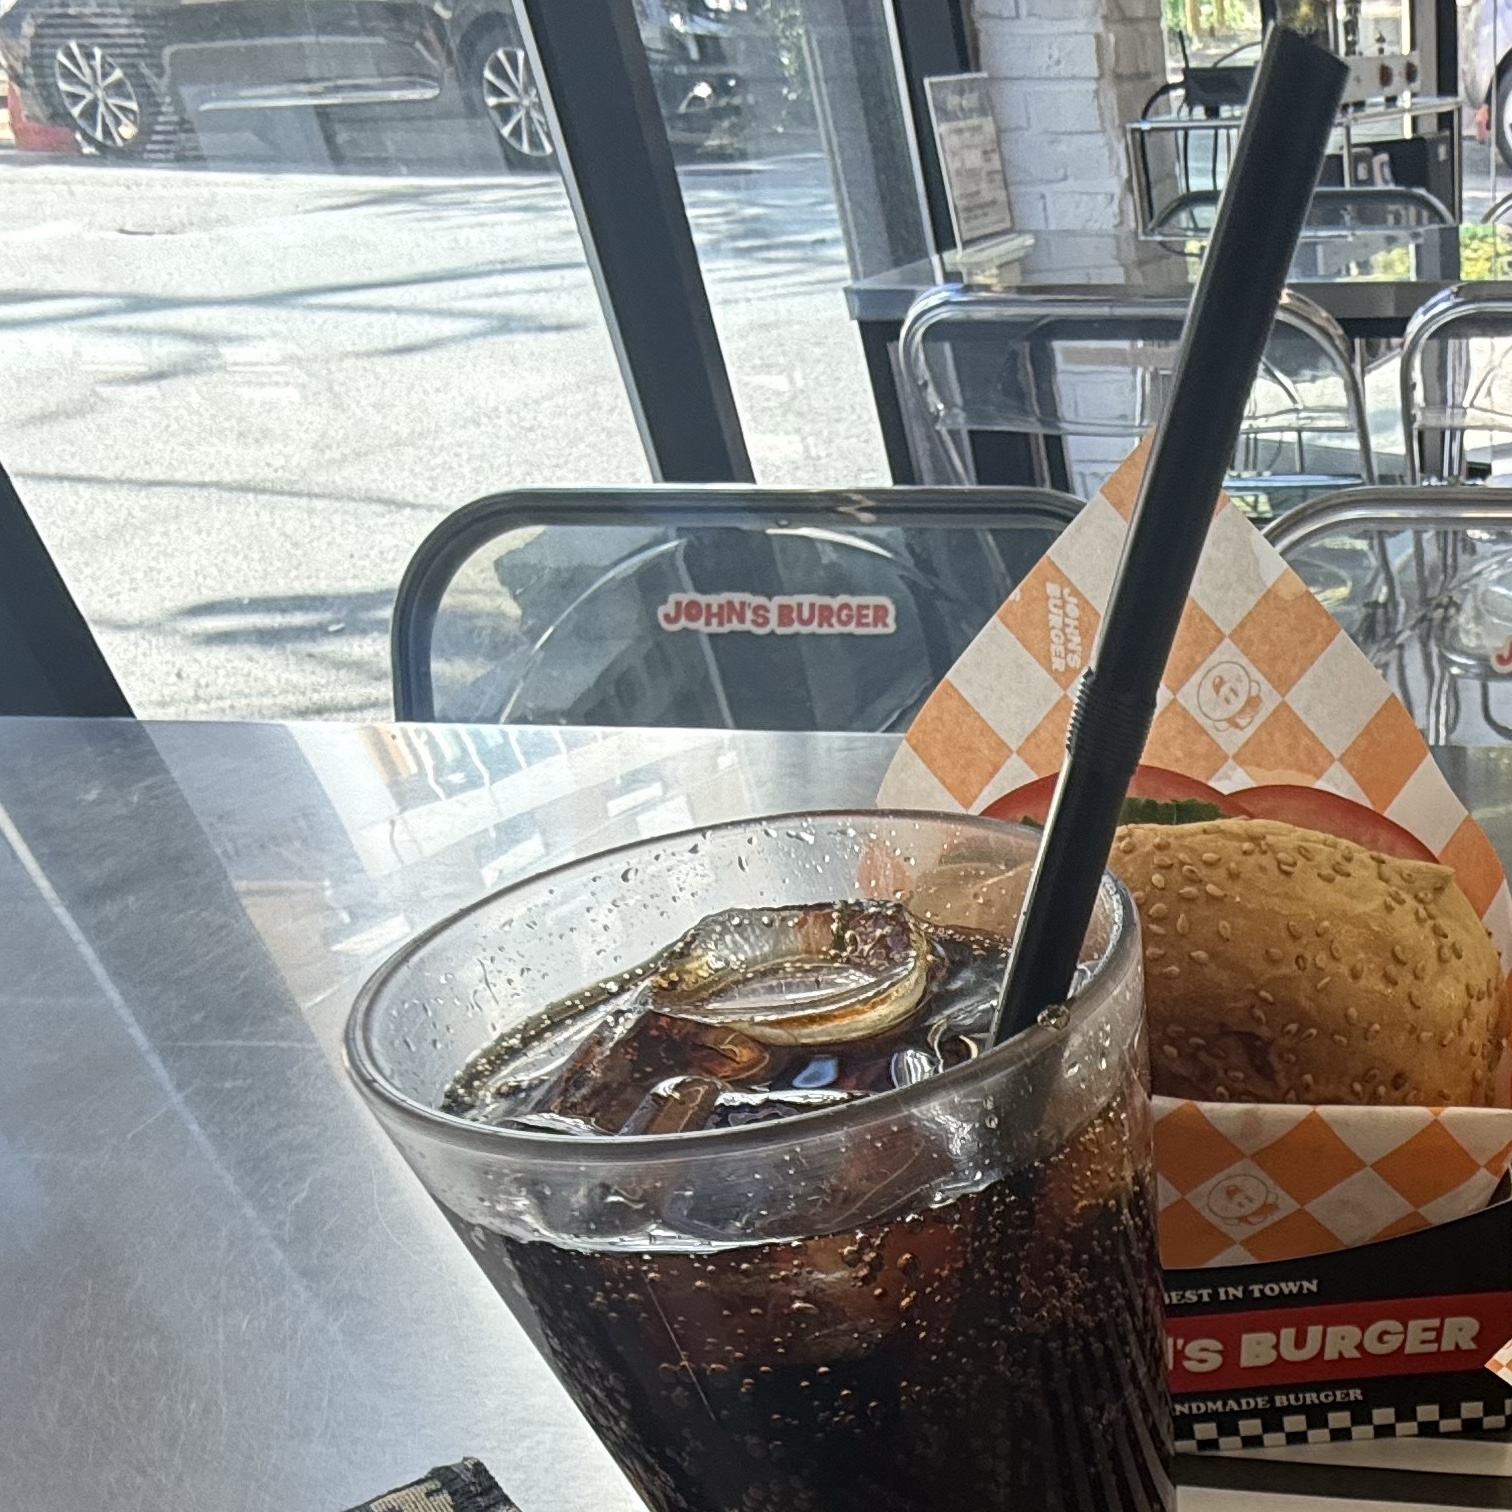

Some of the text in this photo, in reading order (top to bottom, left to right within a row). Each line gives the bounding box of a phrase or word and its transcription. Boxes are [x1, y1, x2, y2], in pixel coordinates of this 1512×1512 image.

[663, 600, 890, 629] JOHN'S BURGER
[1045, 581, 1066, 672] BURGER
[1218, 1286, 1244, 1301] IN
[1249, 1279, 1319, 1298] TOWN
[1239, 1316, 1480, 1368] BURGER
[1173, 1388, 1364, 1416] NDMADE BURGER
